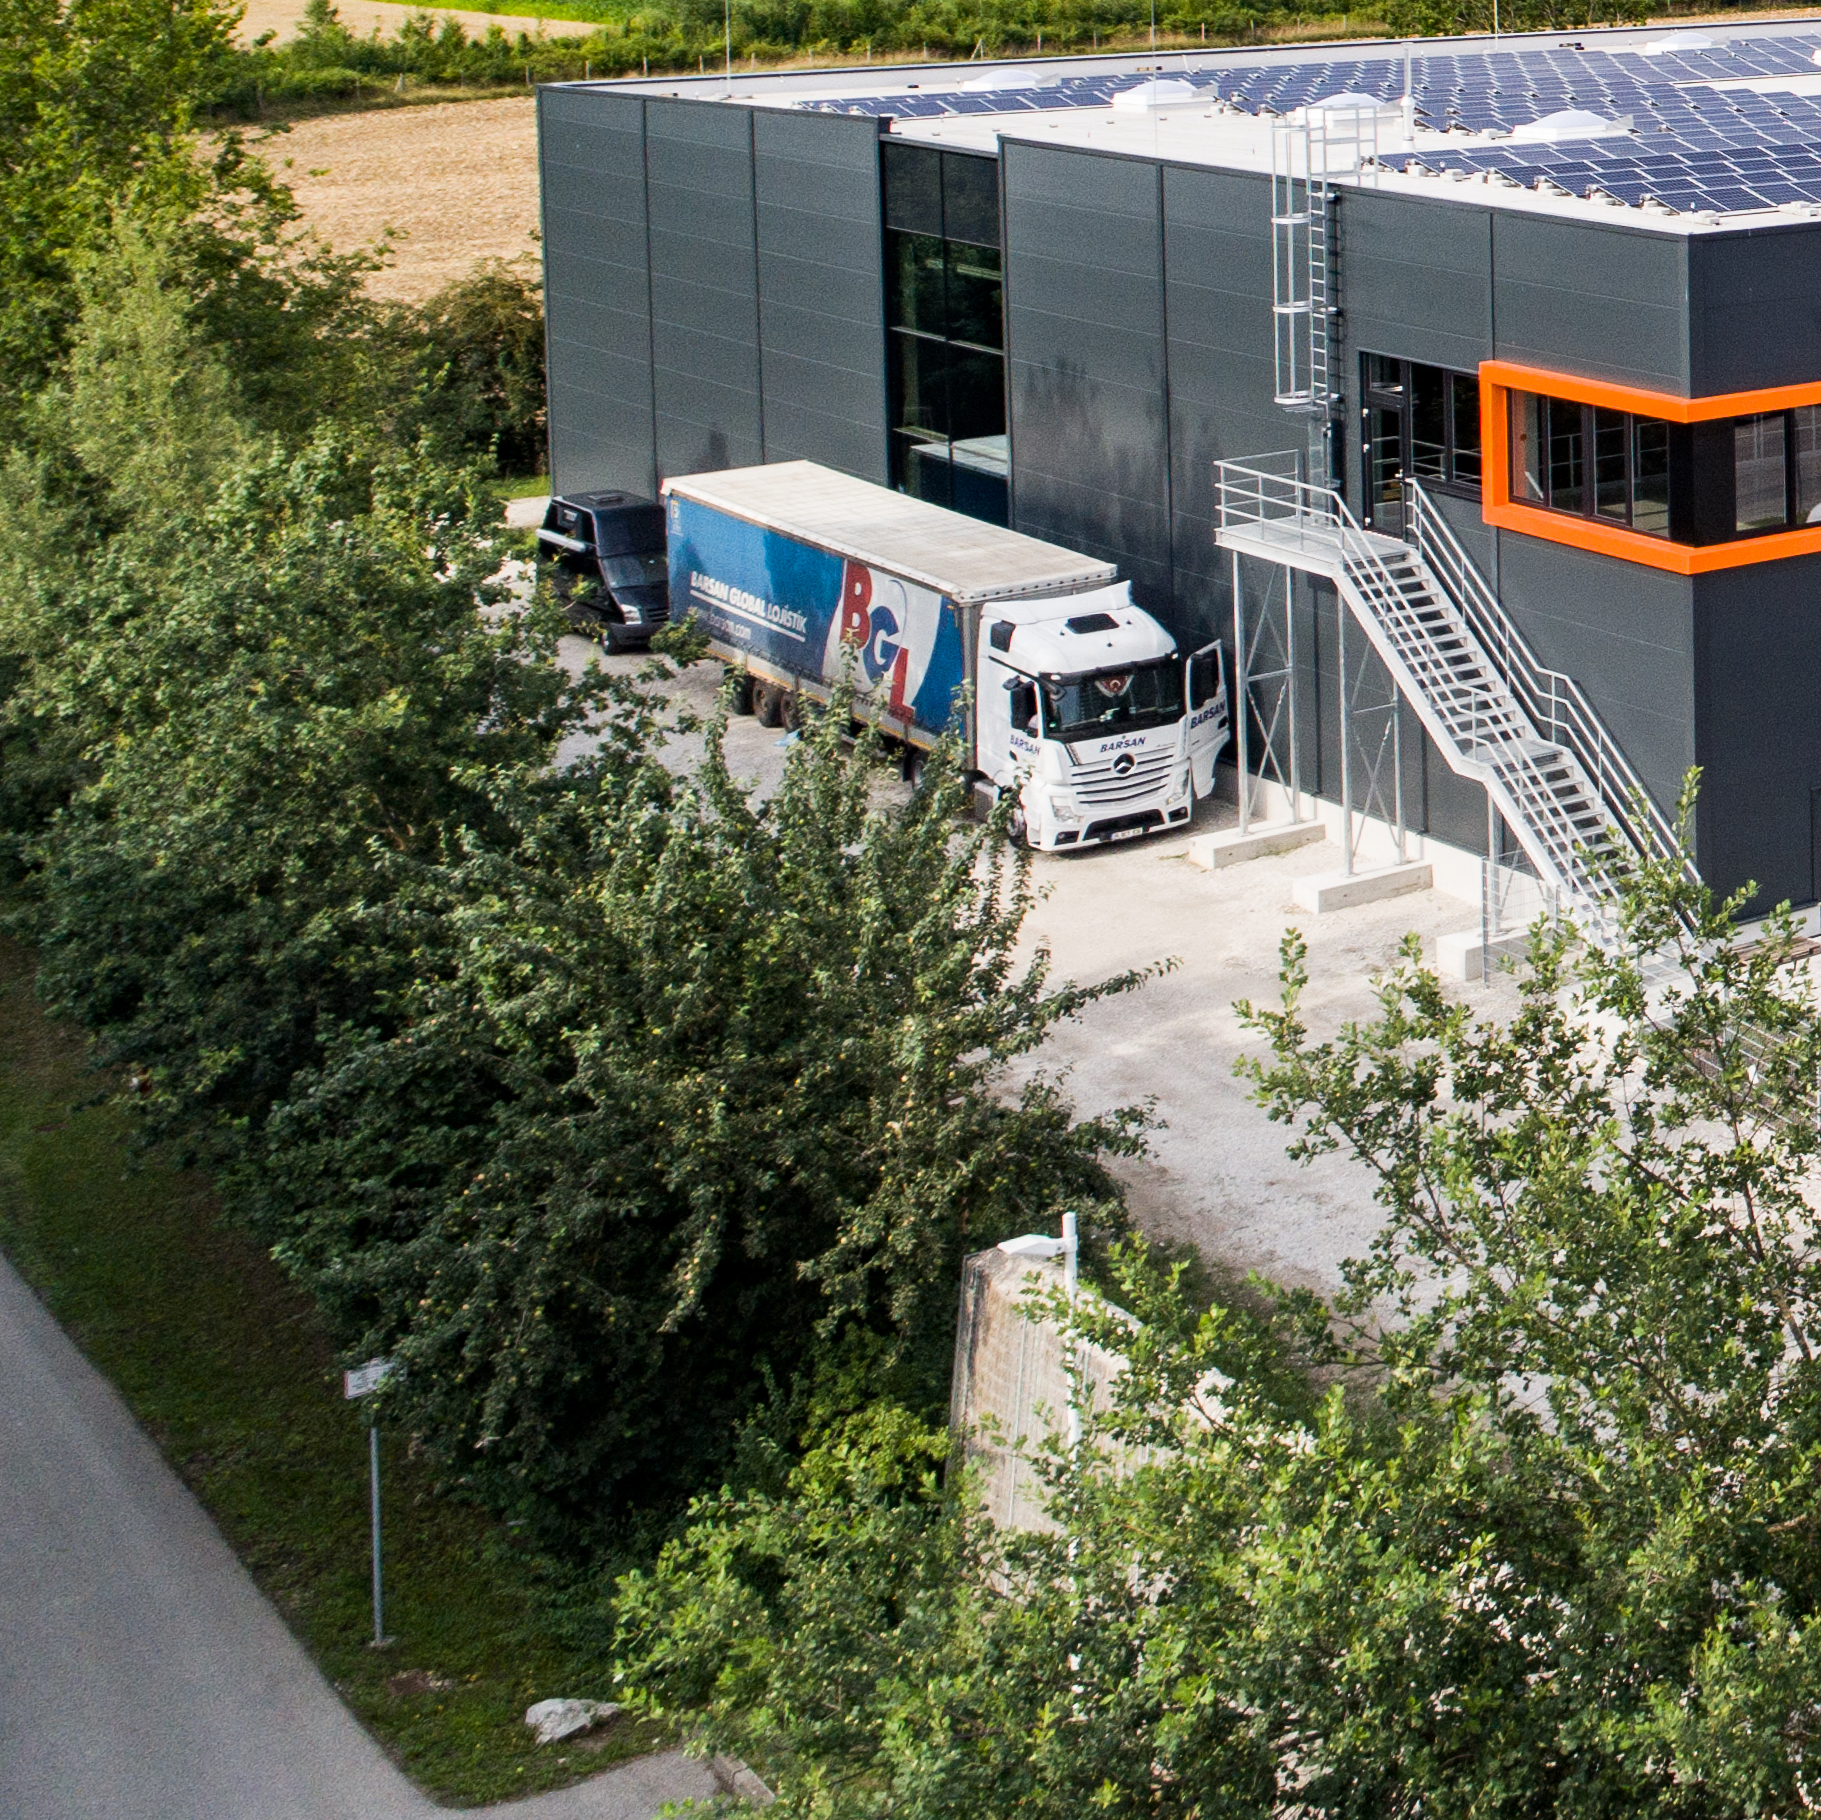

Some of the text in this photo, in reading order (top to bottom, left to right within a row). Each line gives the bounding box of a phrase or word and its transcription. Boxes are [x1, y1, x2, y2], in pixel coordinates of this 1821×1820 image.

[691, 571, 729, 601] BARSAN
[729, 587, 766, 618] GLOBAL
[840, 564, 915, 725] BGL
[1190, 702, 1226, 729] BARSAN
[1009, 733, 1042, 757] BARSAN
[1100, 736, 1147, 754] BARSAN
